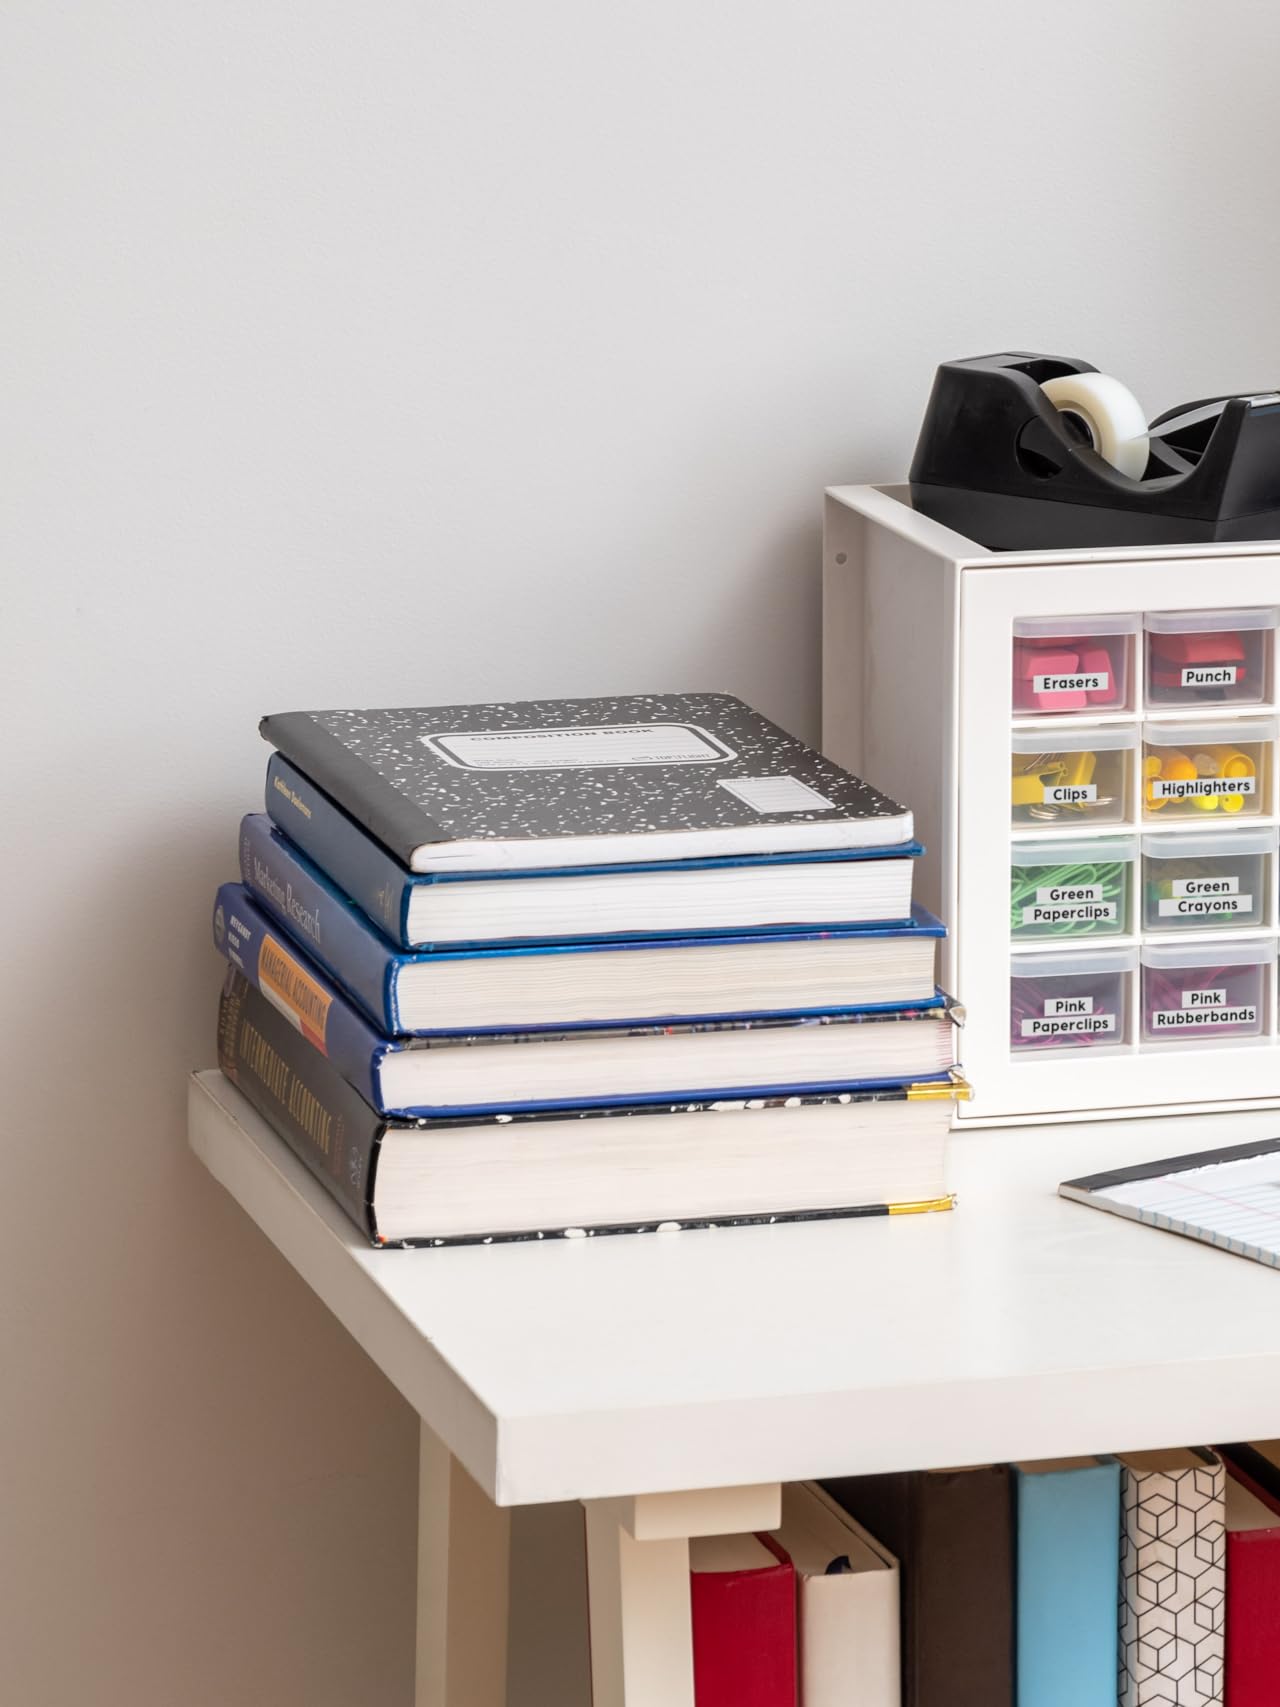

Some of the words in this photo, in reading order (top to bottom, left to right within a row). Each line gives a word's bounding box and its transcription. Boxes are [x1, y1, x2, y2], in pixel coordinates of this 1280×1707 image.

[1043, 676, 1100, 690] Erasers
[1186, 669, 1231, 683] Punch
[470, 731, 597, 741] COMPOSITION
[1053, 788, 1088, 803] Clips
[1161, 780, 1250, 797] Highlighters
[1050, 888, 1094, 901] Green
[1185, 881, 1230, 894] Green
[253, 856, 286, 917] Marketing
[285, 883, 321, 945] Research
[1178, 899, 1238, 914] Crayons
[1033, 906, 1110, 923] Paperclips
[1191, 992, 1221, 1005] Pink
[1055, 1000, 1086, 1013] Pink
[1157, 1009, 1255, 1026] Rubberbands
[1032, 1018, 1109, 1035] Paperclips
[288, 1071, 332, 1155] ACCOUNTING
